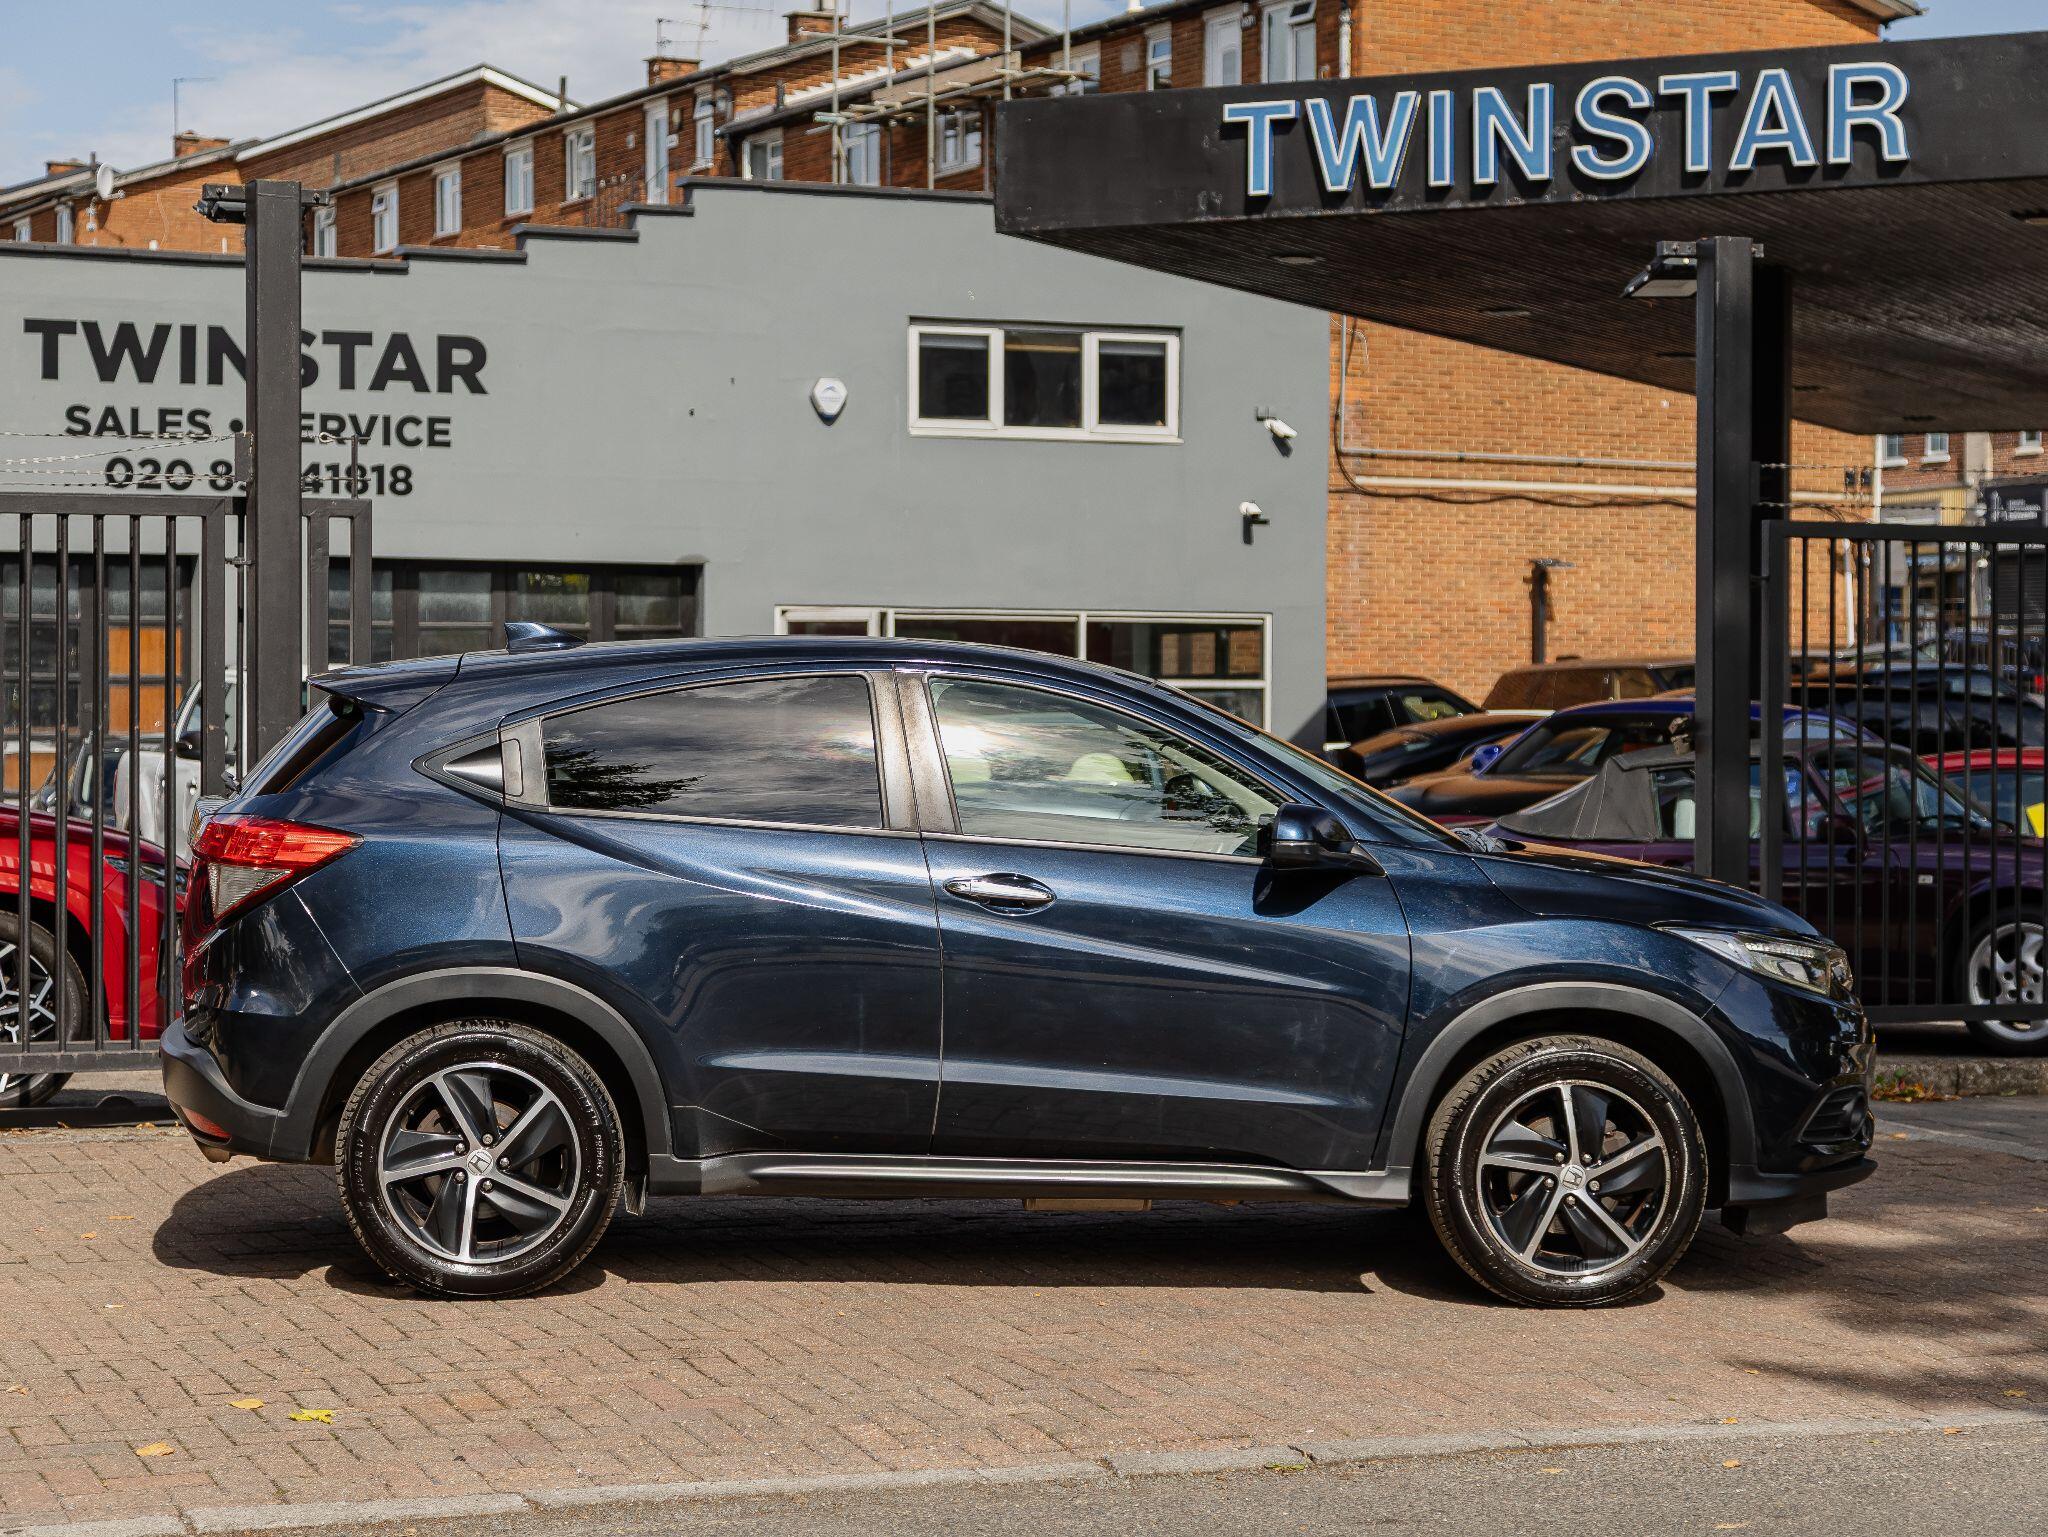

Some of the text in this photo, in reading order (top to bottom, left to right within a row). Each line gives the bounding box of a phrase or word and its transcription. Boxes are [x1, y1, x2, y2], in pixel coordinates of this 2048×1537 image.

[1222, 61, 1910, 197] TWINSTAR
[65, 405, 452, 448] SALES ERVICE
[105, 457, 413, 497] 020 841818
